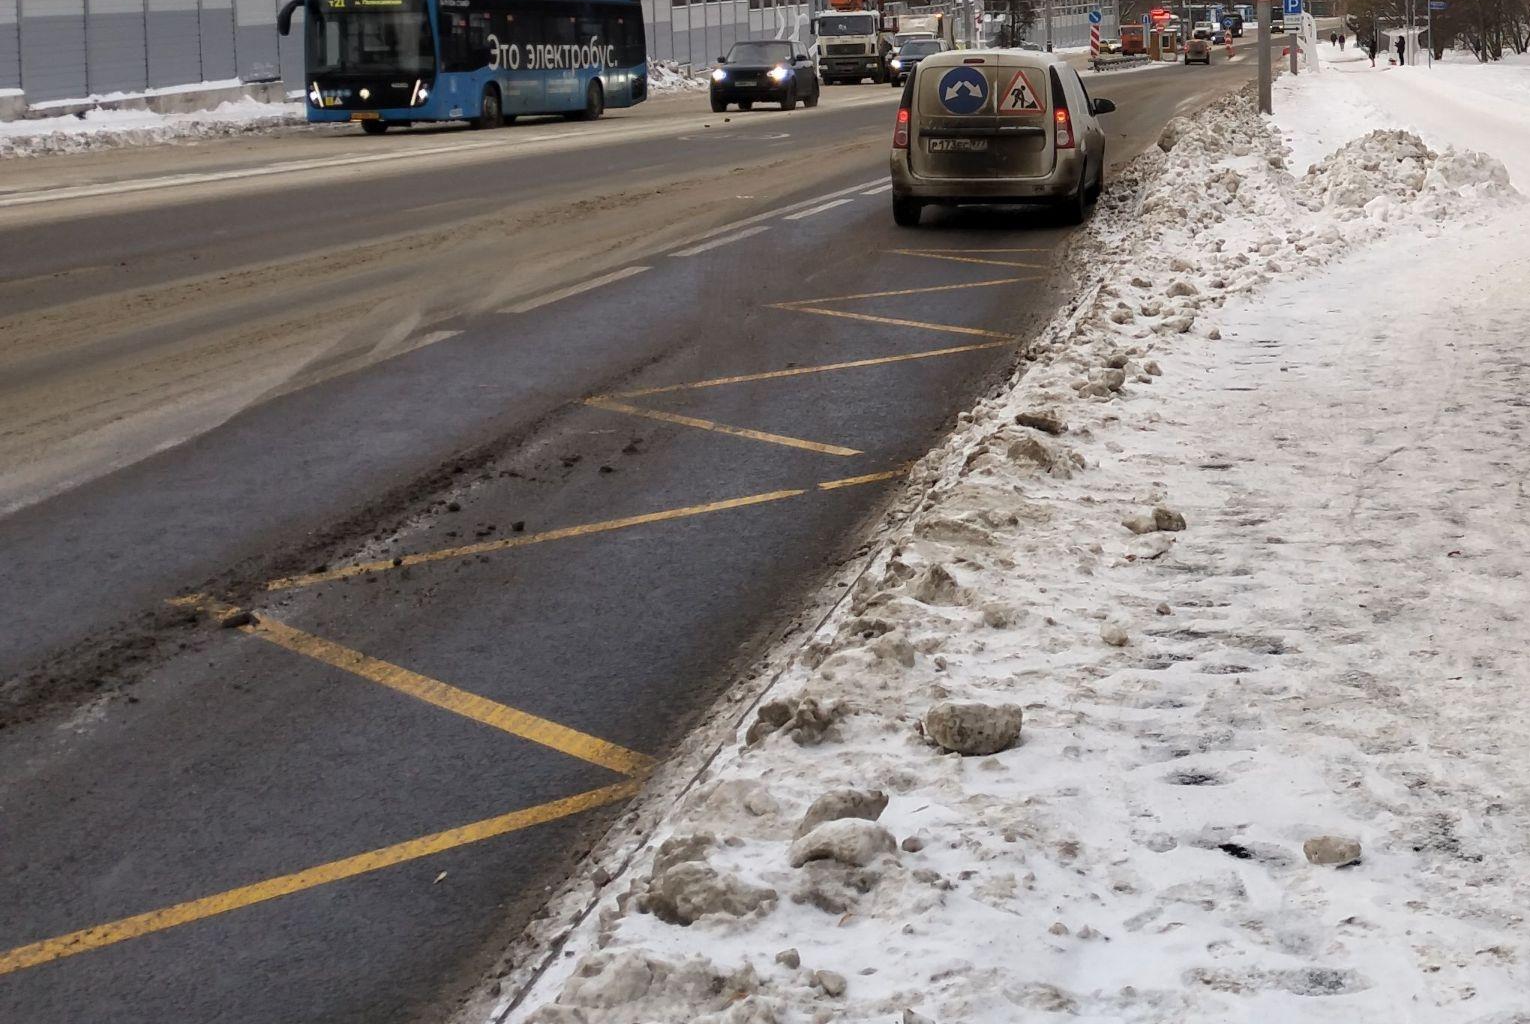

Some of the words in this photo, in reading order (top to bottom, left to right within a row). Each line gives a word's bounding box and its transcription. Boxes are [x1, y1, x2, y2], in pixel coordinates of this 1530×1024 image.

[1287, 0, 1299, 12] P
[487, 33, 520, 71] Это
[525, 35, 618, 75] электробус.
